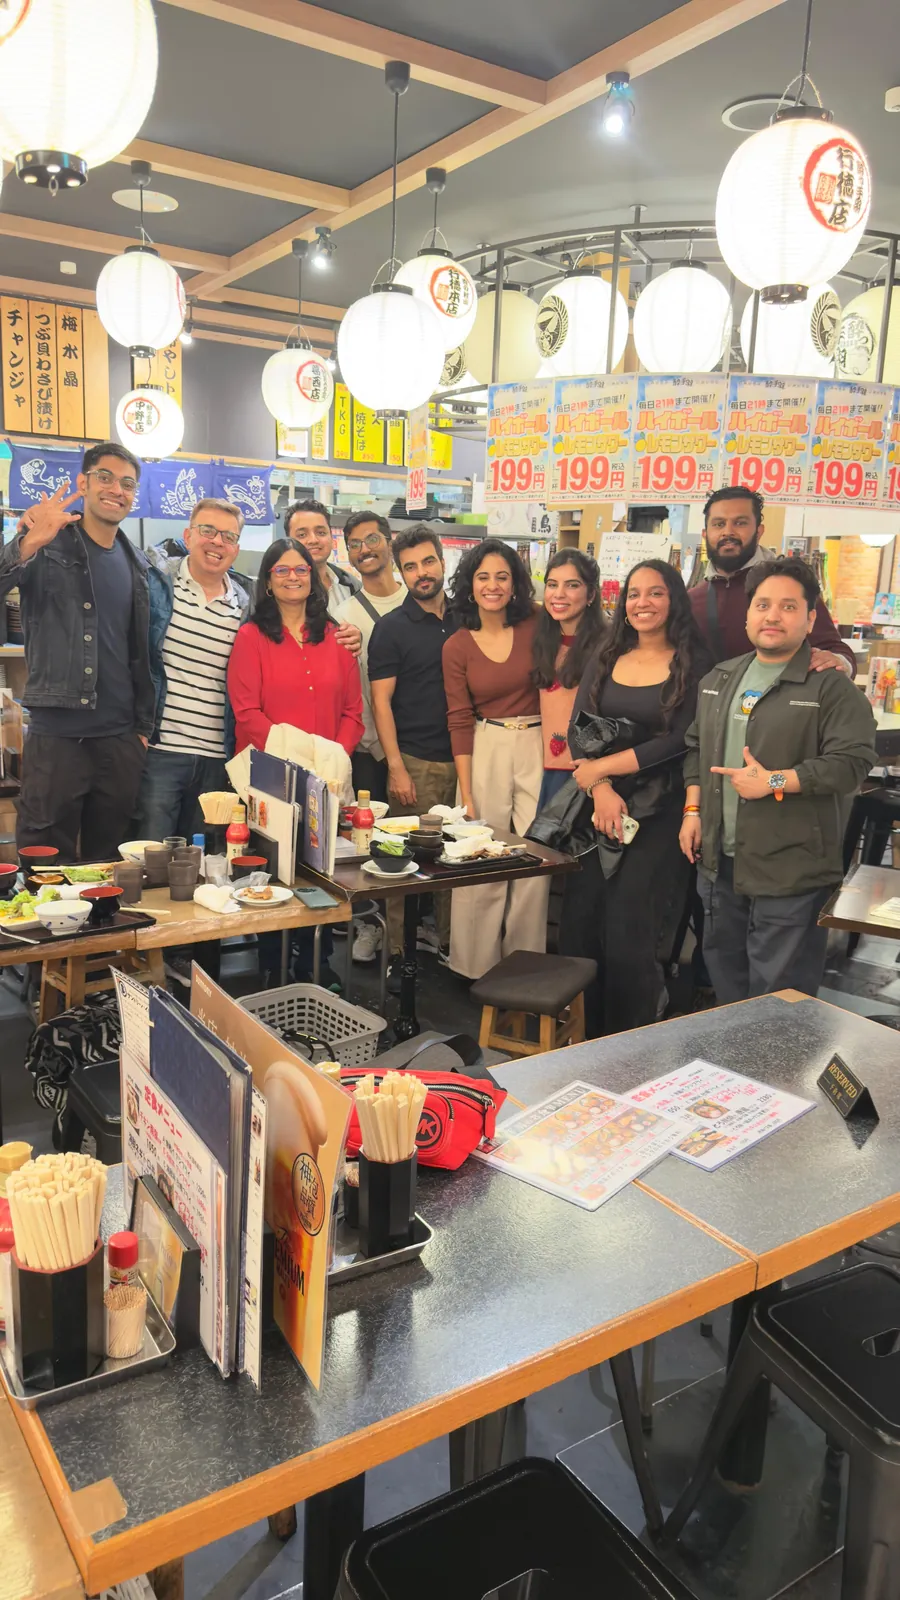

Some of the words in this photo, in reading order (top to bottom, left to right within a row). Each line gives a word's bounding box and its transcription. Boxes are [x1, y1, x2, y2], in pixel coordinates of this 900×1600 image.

[7, 309, 26, 408] チャンジャ
[61, 314, 79, 388] 梅水晶
[35, 313, 53, 430] つぶ貝わさび漬け
[135, 401, 145, 432] 中野店
[488, 413, 548, 437] ハイボール
[555, 409, 629, 433] ハイボール
[636, 408, 719, 430] ハイボール
[728, 410, 808, 434] ハイボール
[815, 416, 883, 440] ハイボール
[496, 436, 548, 458] レモンサワー
[564, 434, 628, 455] レモンサワー
[647, 433, 717, 454] レモンサワー
[737, 434, 805, 456] レモンサワー
[821, 439, 882, 462] レモンサワー
[828, 1063, 857, 1099] RESERVED
[144, 1085, 182, 1138] 定食メニュー
[300, 1156, 319, 1200] 神泡
